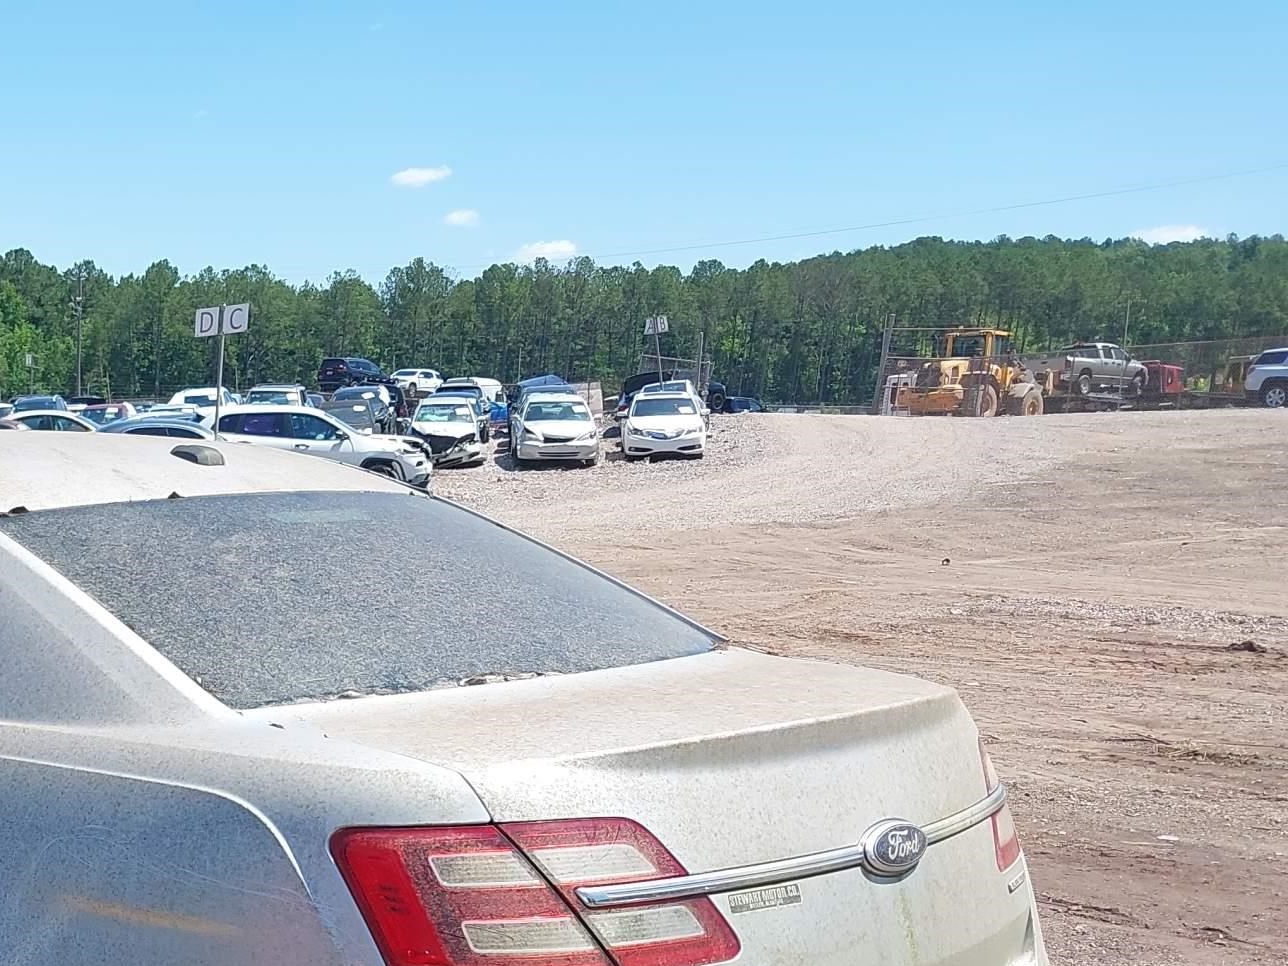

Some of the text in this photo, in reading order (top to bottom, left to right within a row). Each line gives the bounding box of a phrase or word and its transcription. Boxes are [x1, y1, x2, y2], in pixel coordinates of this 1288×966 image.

[200, 312, 213, 333] D
[230, 308, 243, 330] C
[888, 830, 920, 860] Ford
[728, 891, 763, 907] STEWART
[761, 887, 788, 901] MOTOR
